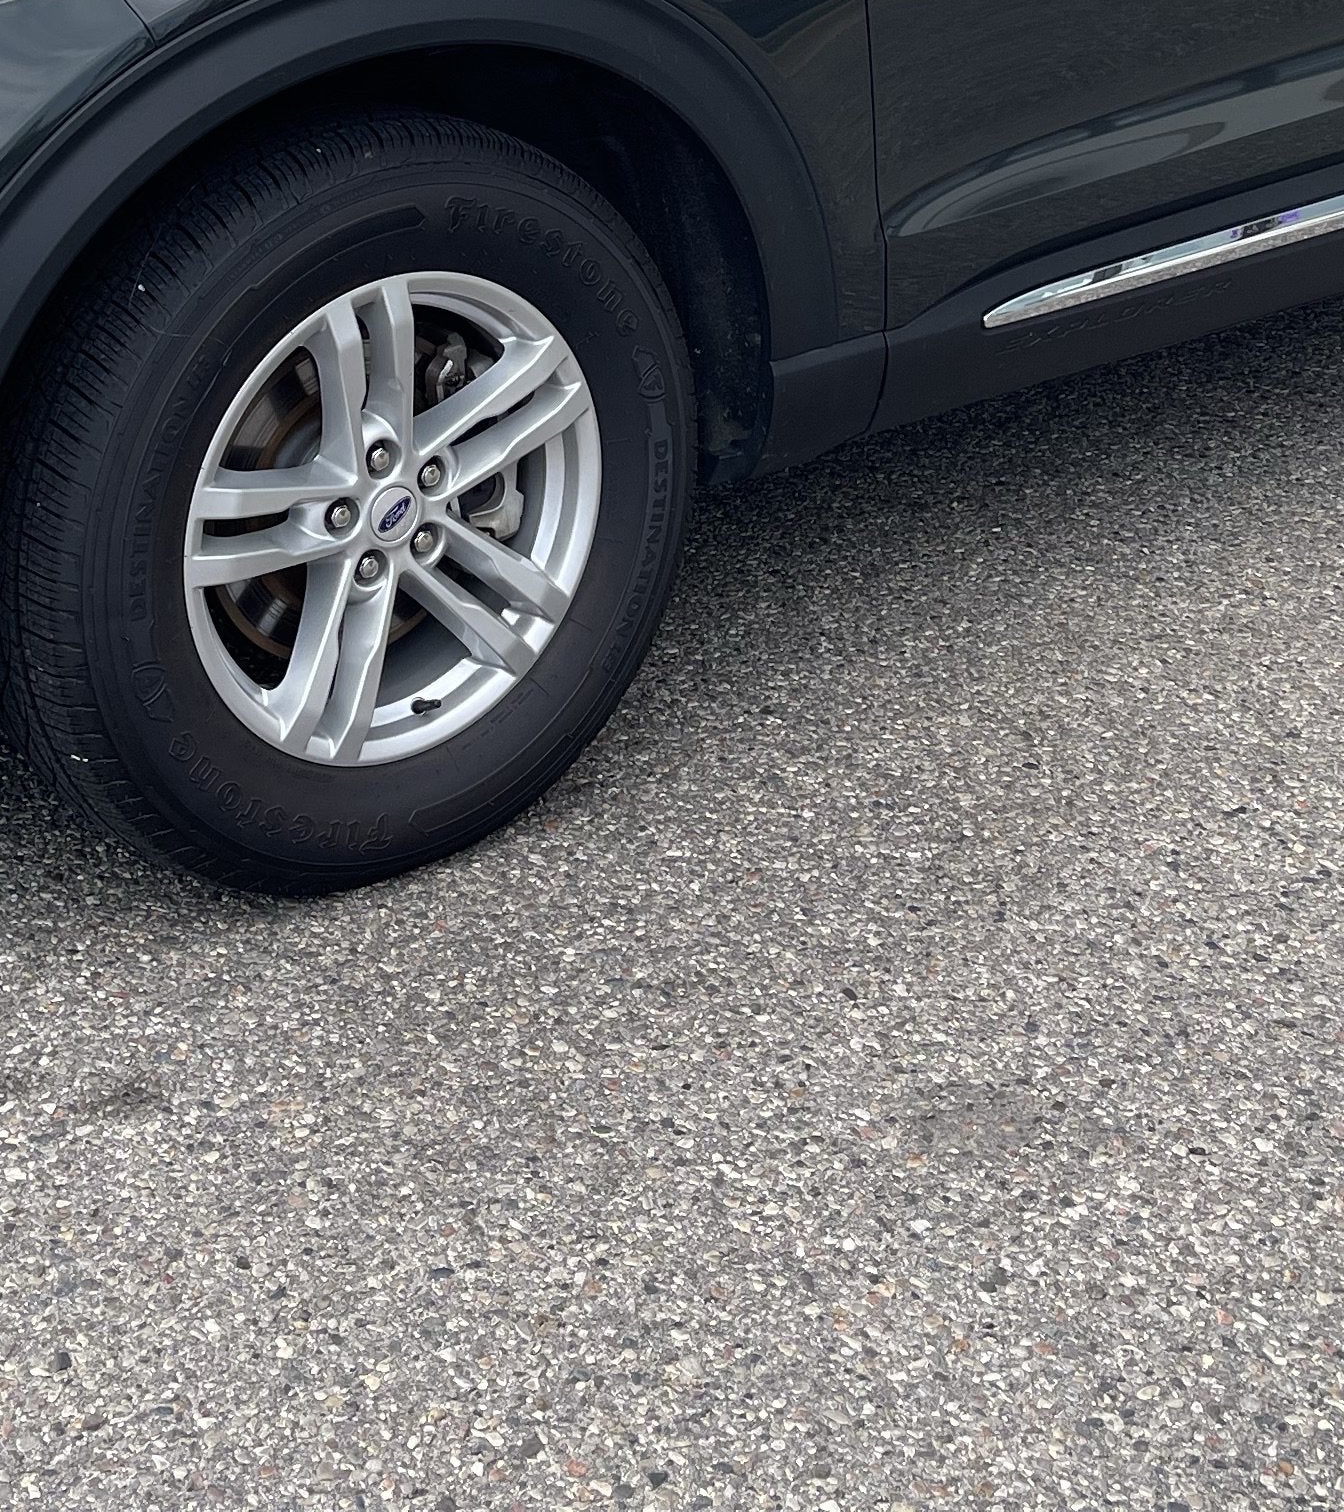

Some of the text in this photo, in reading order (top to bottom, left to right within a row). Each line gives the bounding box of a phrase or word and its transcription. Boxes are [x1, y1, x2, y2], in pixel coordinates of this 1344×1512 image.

[444, 195, 641, 336] Firestone
[616, 438, 669, 639] DESTINATION
[167, 730, 394, 856] Firestone
